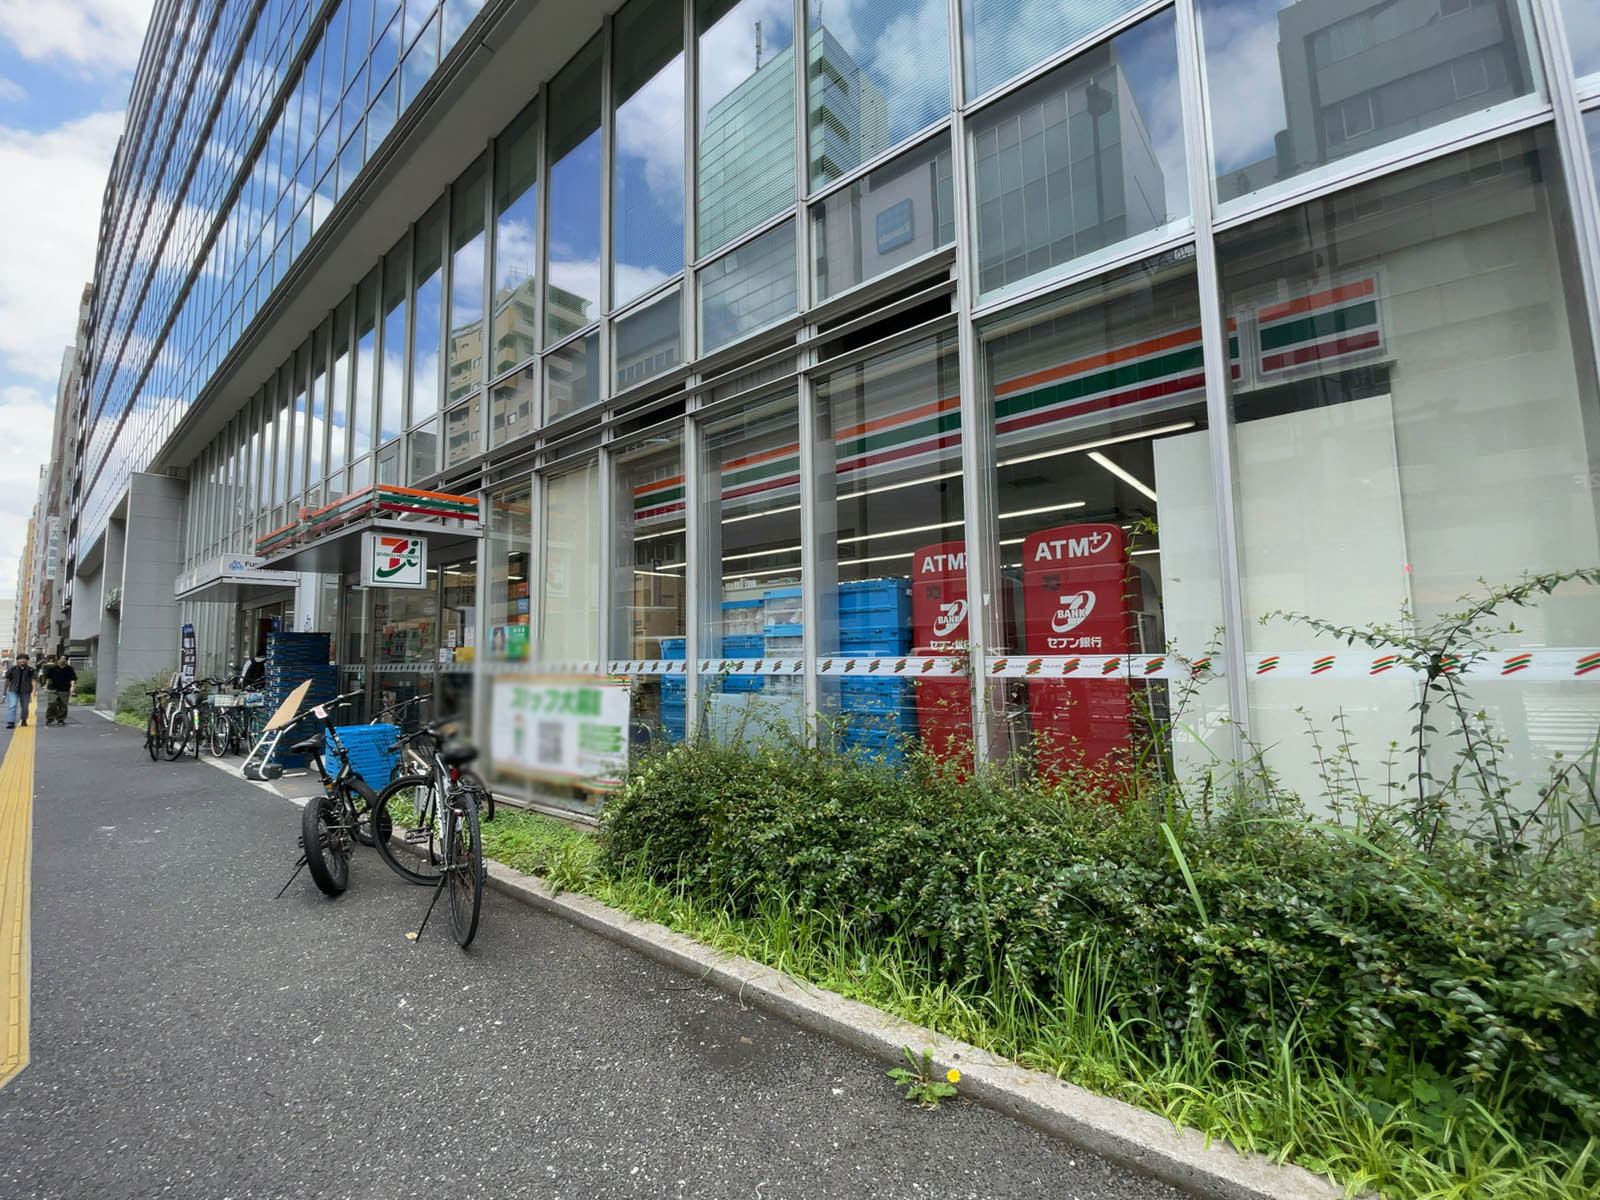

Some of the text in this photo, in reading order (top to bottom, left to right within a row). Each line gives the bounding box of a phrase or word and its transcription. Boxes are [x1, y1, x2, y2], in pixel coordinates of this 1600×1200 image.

[1057, 608, 1088, 620] BANK
[1047, 637, 1102, 649] セブン銀行
